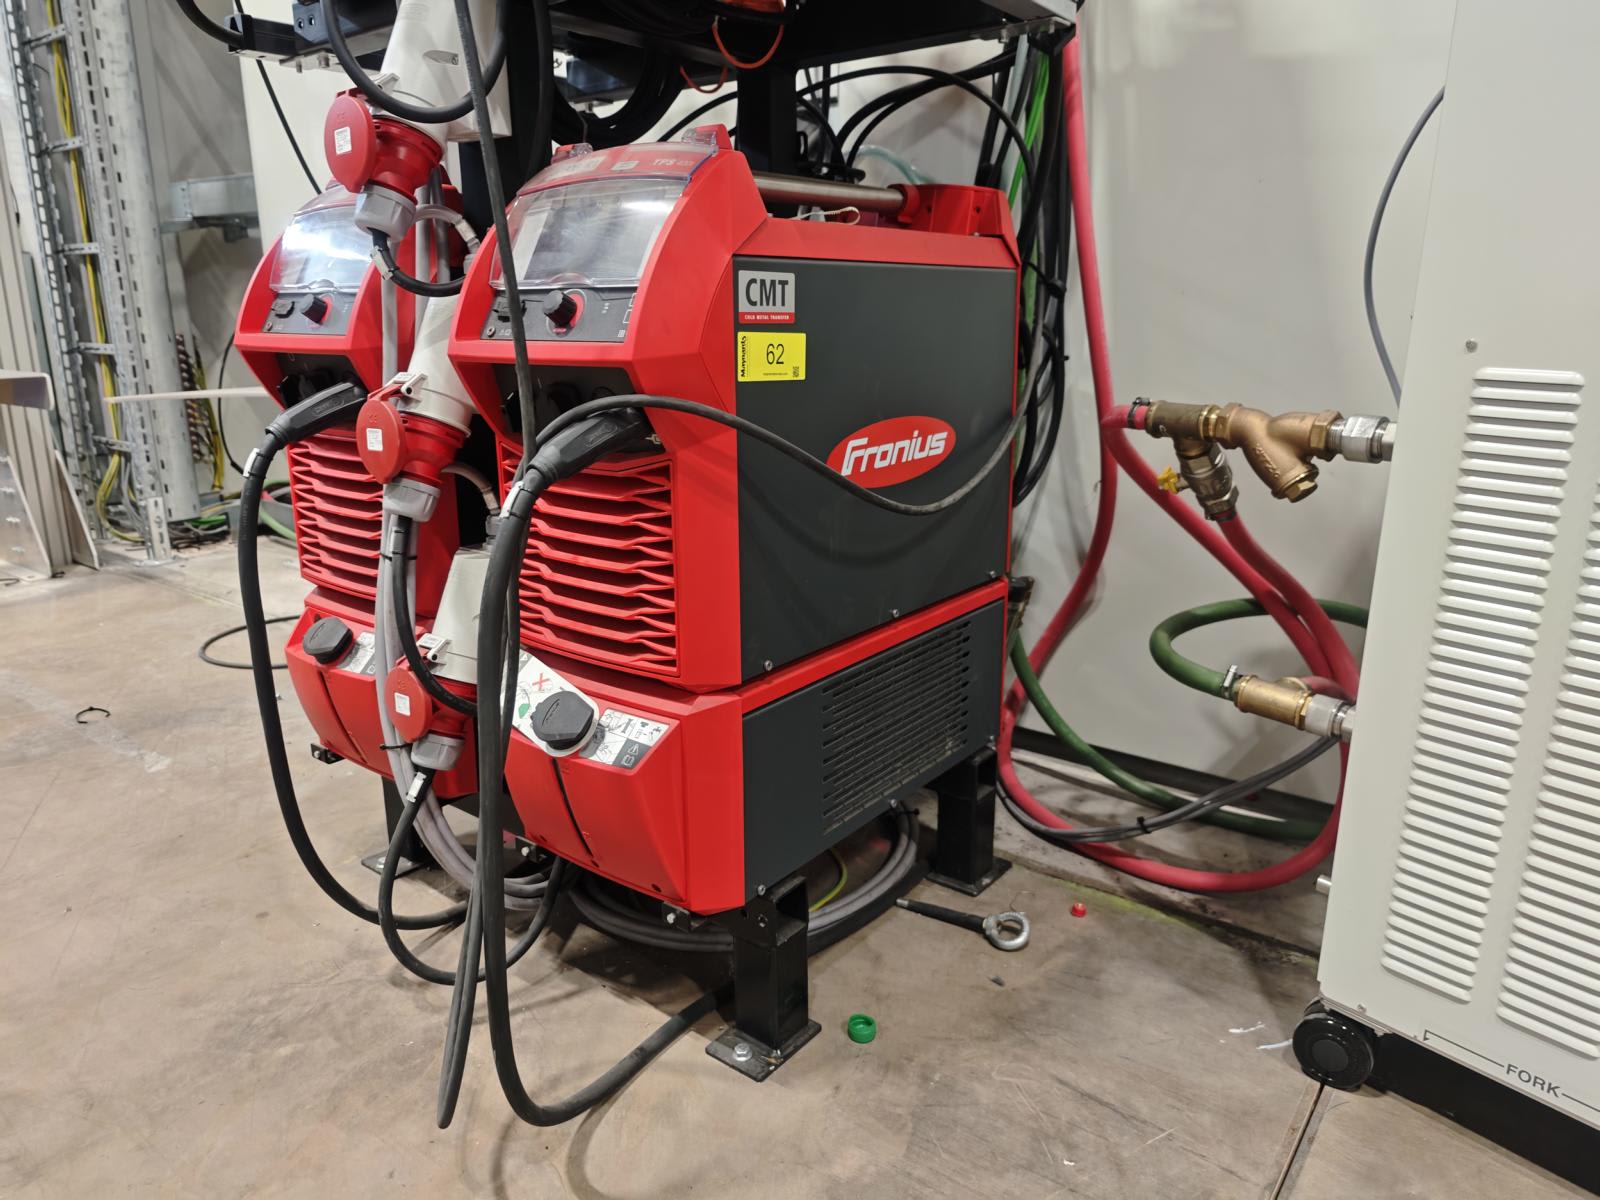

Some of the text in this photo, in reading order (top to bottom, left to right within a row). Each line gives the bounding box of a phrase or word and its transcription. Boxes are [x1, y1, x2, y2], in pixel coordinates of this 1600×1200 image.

[745, 278, 789, 306] CMT
[766, 343, 785, 365] 62
[841, 430, 948, 476] Fronius
[1506, 1063, 1560, 1098] FORK
